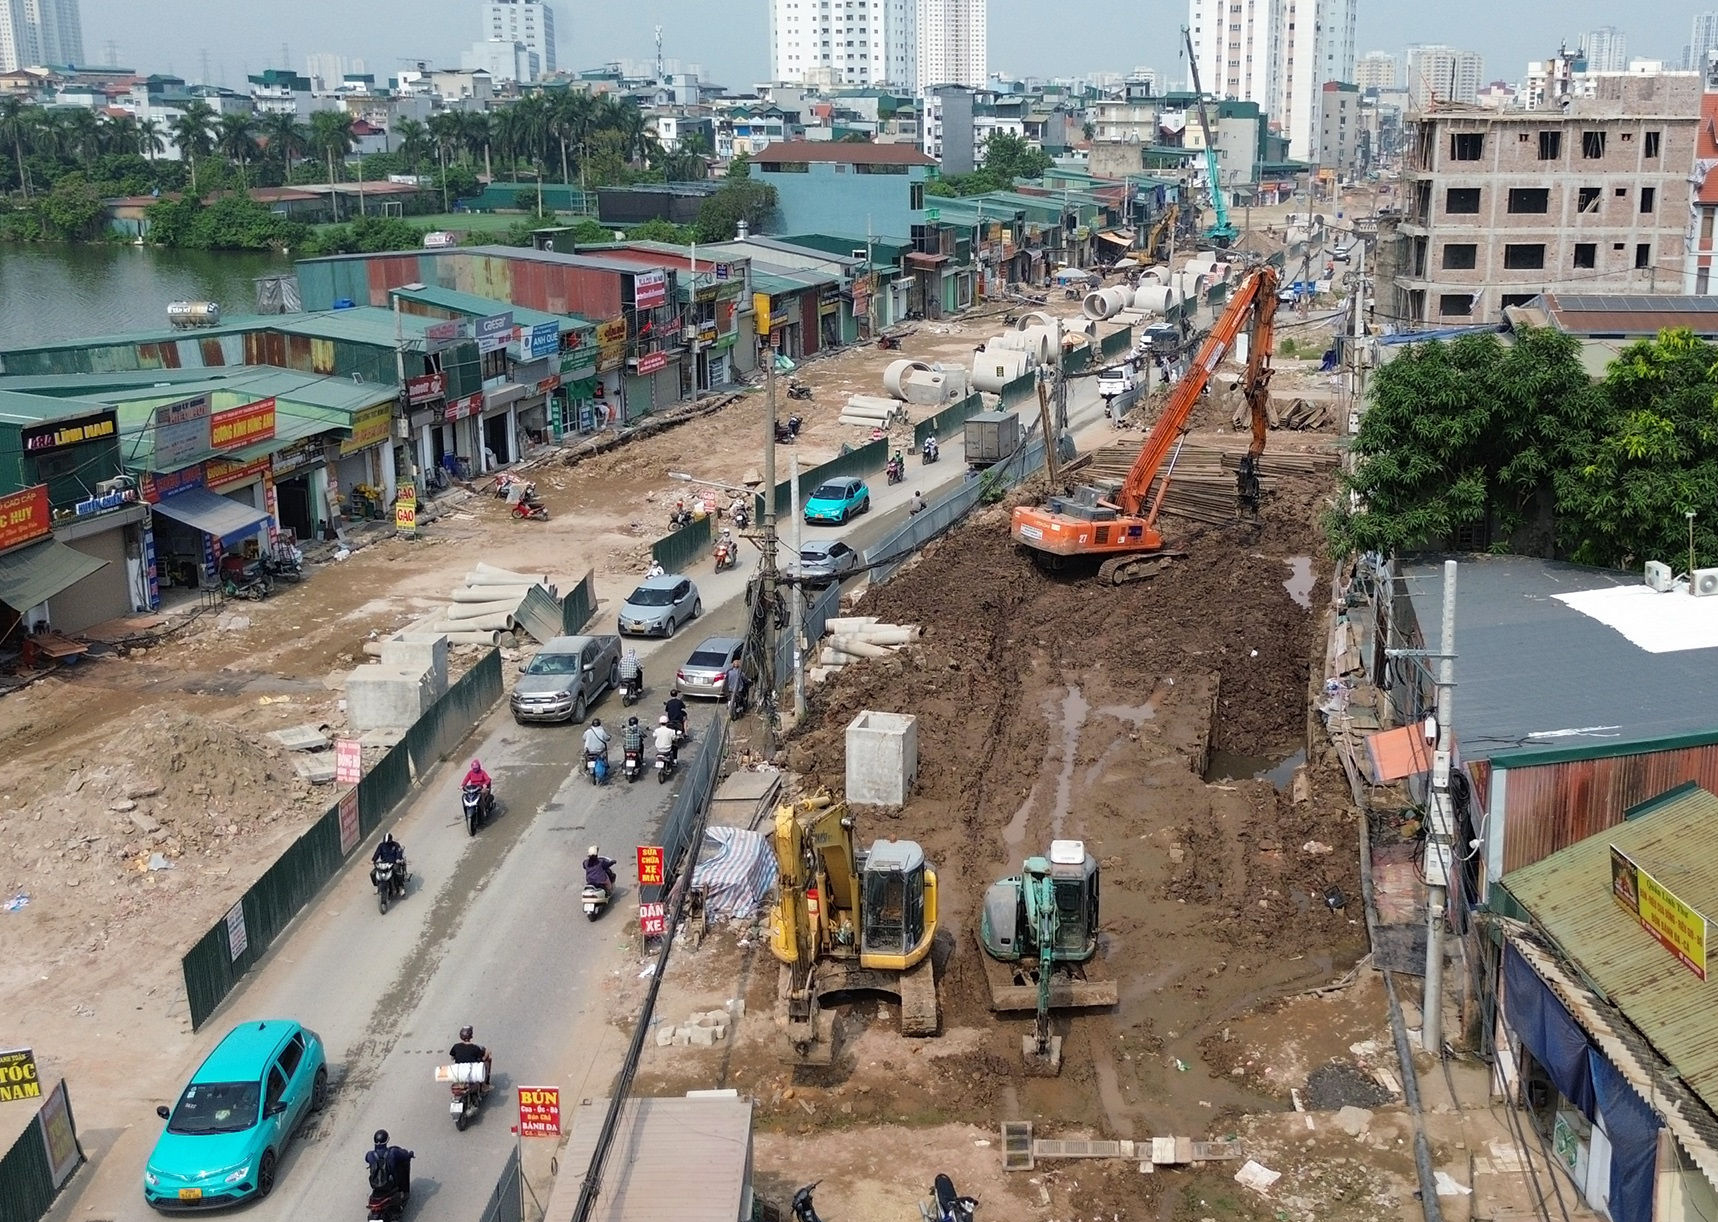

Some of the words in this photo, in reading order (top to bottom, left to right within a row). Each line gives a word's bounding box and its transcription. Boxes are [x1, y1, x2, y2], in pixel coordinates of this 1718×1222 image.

[54, 427, 84, 446] LĨNH
[84, 420, 114, 439] NAM
[10, 506, 33, 525] HUY
[1079, 534, 1088, 543] 27
[642, 872, 660, 882] MÁY
[645, 865, 657, 874] XE
[645, 919, 662, 932] XE
[0, 1061, 36, 1083] TÓC
[0, 1082, 40, 1102] NAM
[520, 1088, 557, 1105] BÚN
[522, 1120, 545, 1131] BÁNH
